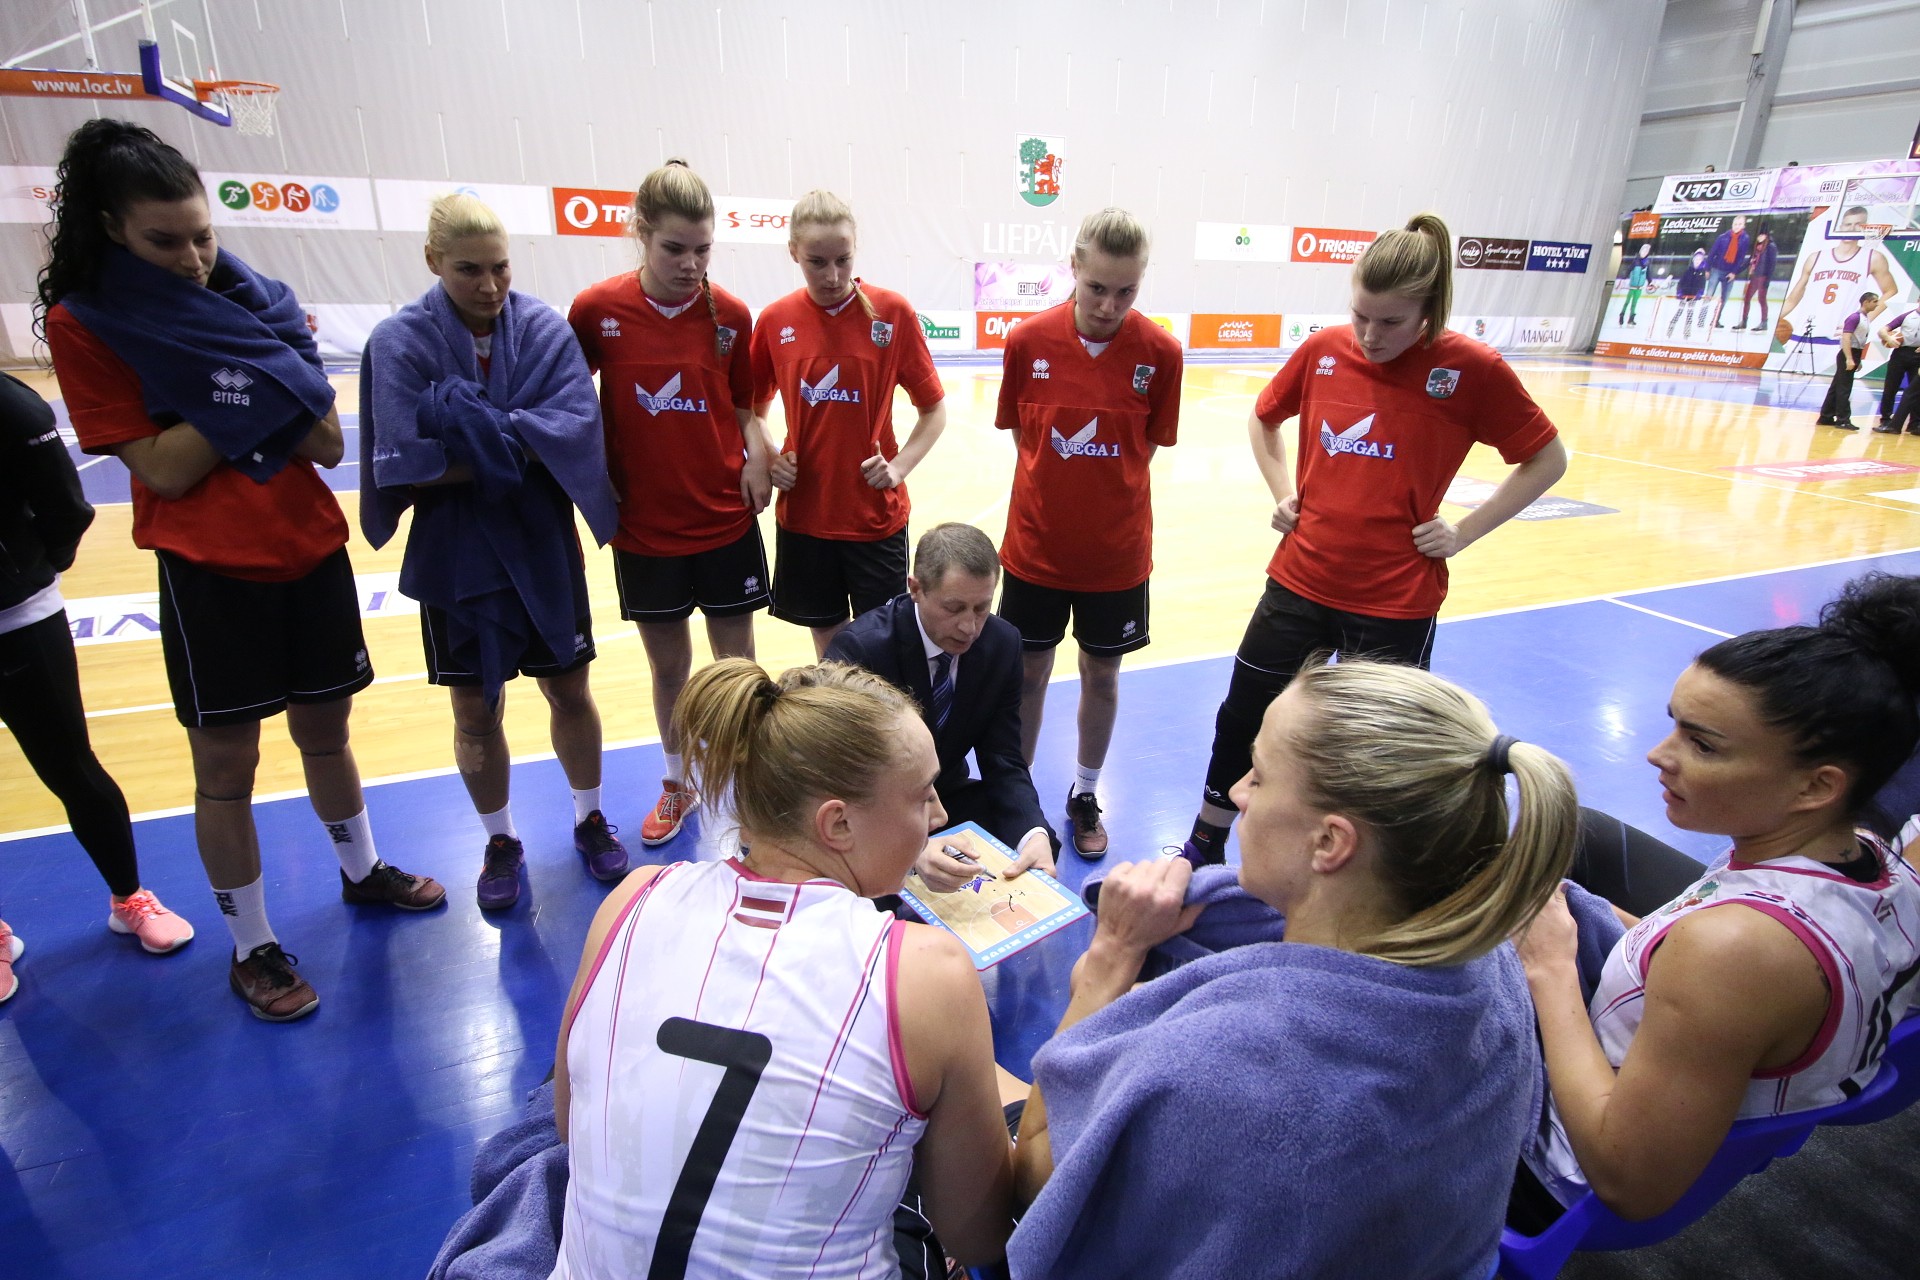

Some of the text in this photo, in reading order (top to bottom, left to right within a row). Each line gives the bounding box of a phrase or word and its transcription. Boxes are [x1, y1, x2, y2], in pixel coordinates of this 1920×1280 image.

[32, 78, 132, 95] www.loc.lv
[1532, 245, 1562, 257] HOTEL
[1813, 269, 1861, 284] NEW YORK
[1823, 283, 1839, 305] 6
[1520, 329, 1564, 343] MANGALI
[1629, 346, 1744, 365] Nāc slidot un spēlēt hokeju!
[807, 388, 860, 403] VEGA 1
[646, 396, 707, 413] VEGA 1
[1059, 441, 1120, 457] VEGA 1
[1327, 435, 1393, 459] VEGA 1
[647, 1016, 773, 1280] 7
